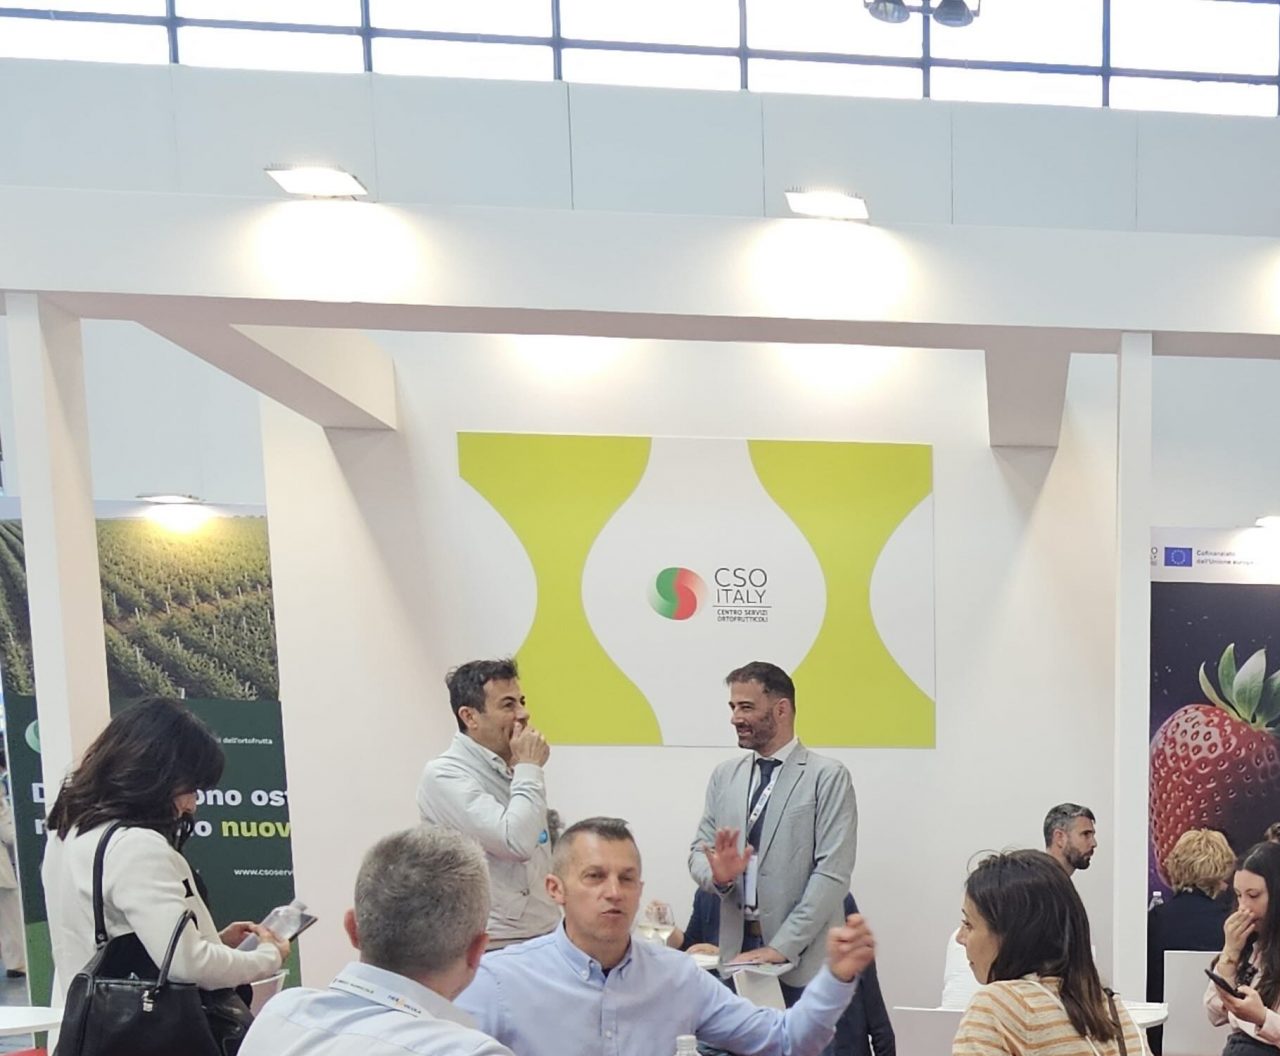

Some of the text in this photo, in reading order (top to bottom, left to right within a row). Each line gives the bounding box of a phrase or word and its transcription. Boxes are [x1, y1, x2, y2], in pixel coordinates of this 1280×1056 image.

[714, 567, 768, 588] CSO
[716, 588, 767, 604] ITALY
[717, 608, 743, 616] CENTRO
